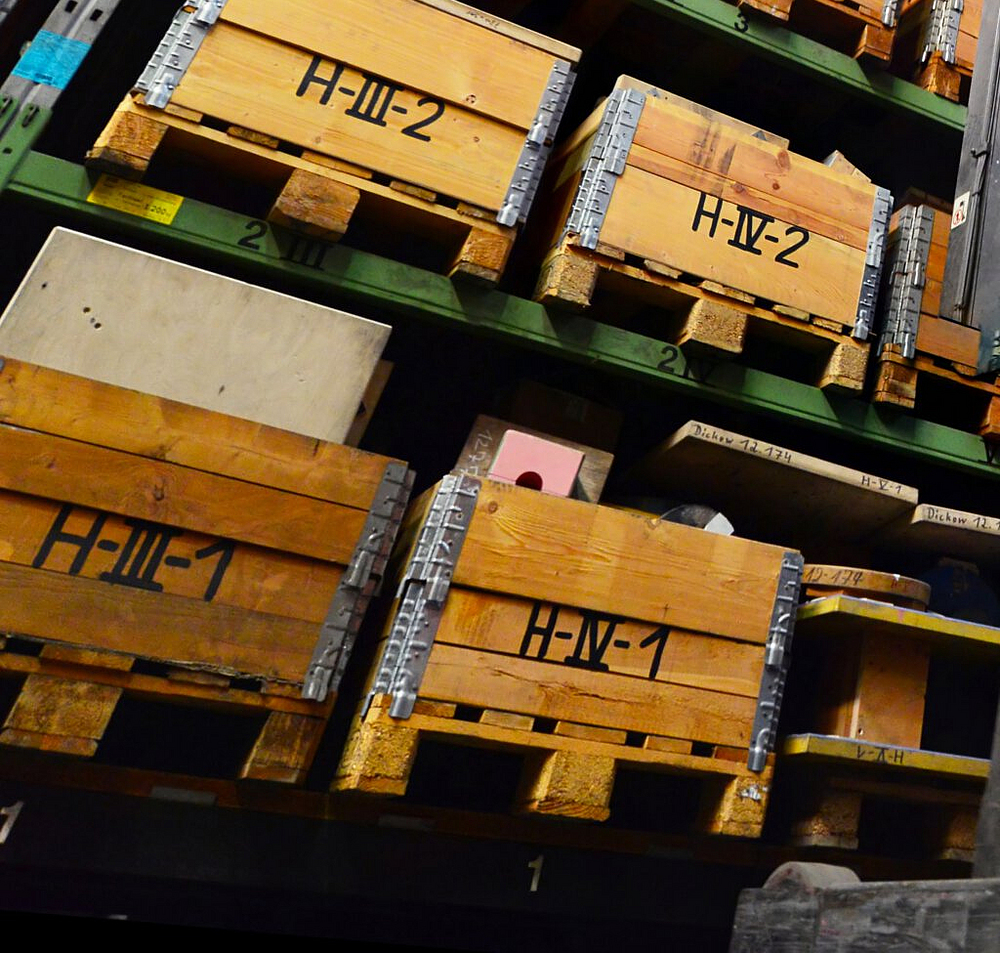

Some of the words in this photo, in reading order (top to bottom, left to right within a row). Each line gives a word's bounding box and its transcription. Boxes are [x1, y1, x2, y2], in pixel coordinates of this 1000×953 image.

[732, 12, 751, 34] 3
[295, 54, 446, 144] H-III-2
[237, 220, 269, 251] 2
[692, 192, 811, 269] H-IV-2
[657, 345, 680, 374] 2
[927, 506, 968, 526] Dickow
[33, 503, 236, 603] H-III-1
[519, 602, 671, 680] H-IV-1
[0, 799, 25, 844] 1
[528, 854, 544, 892] 1
